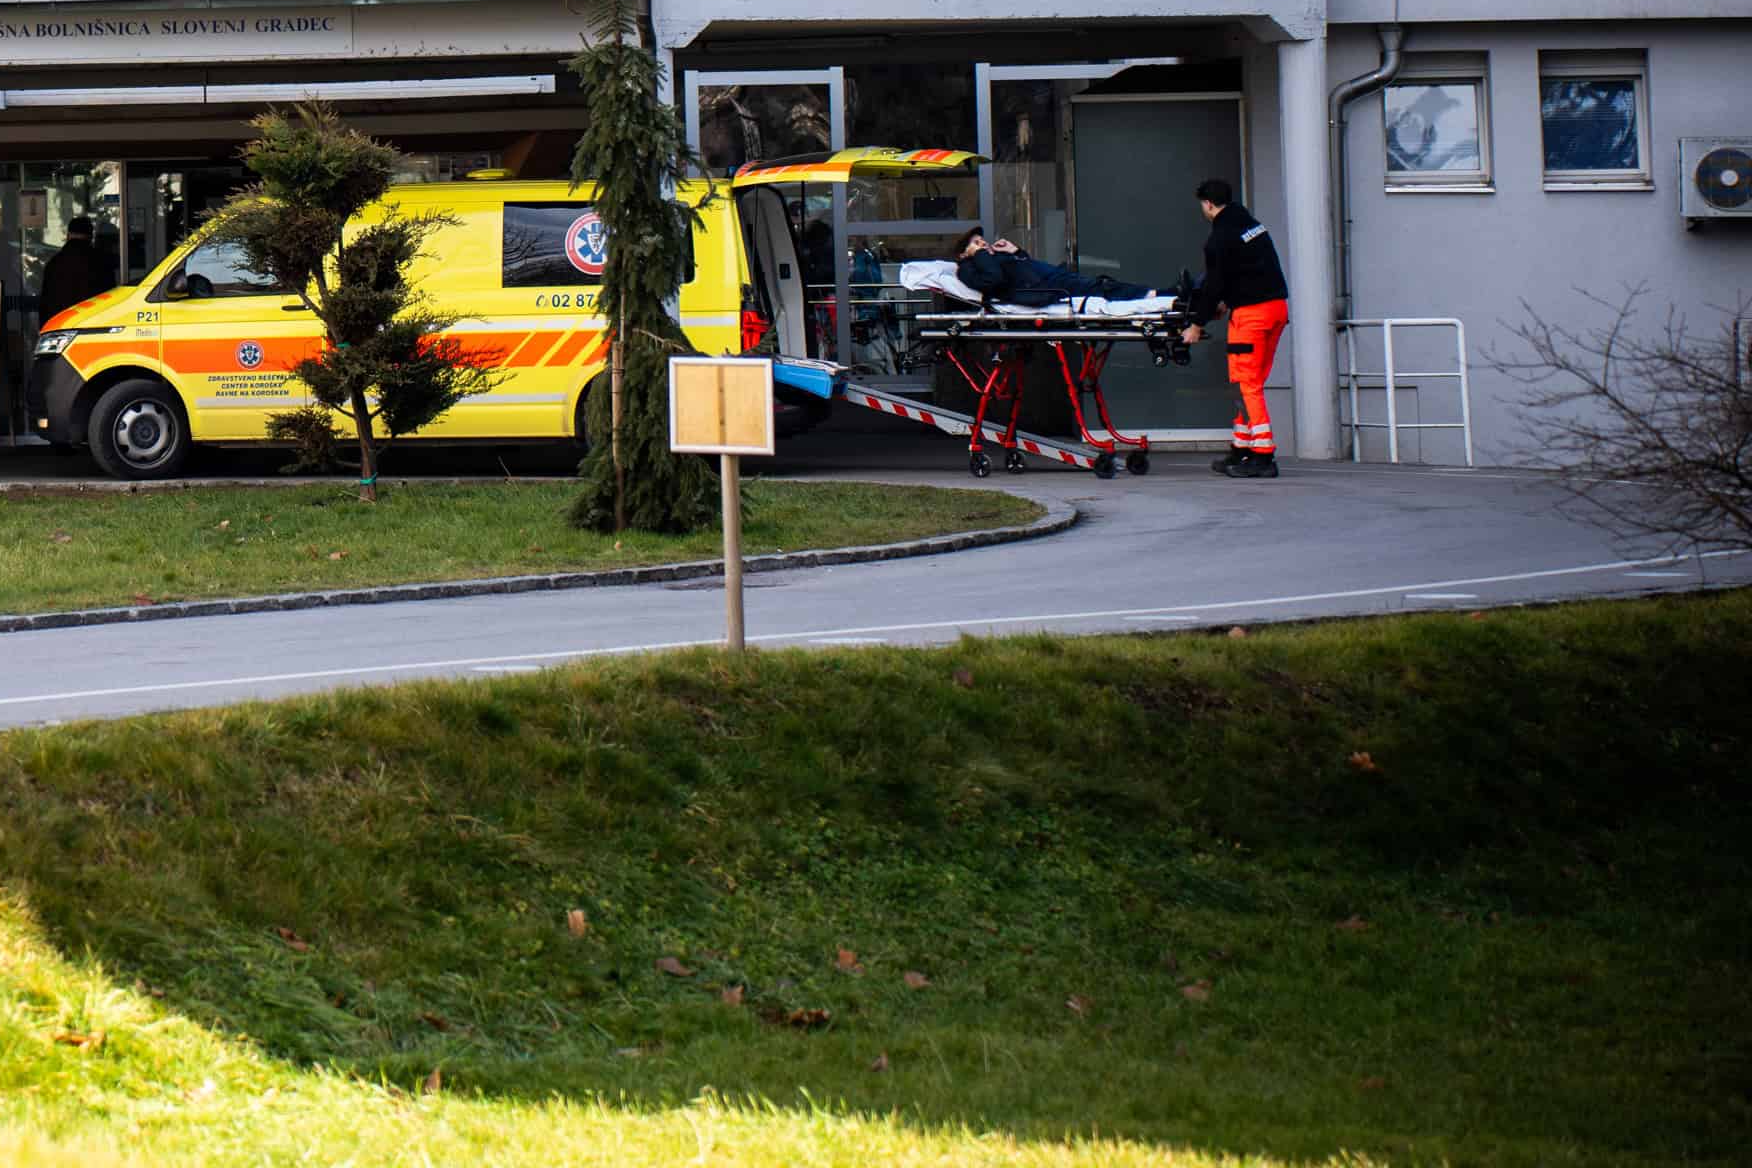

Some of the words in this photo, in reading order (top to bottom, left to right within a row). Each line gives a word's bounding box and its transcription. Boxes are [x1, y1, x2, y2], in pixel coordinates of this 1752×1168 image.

[35, 16, 151, 38] BOLNIŠNICA
[161, 18, 247, 35] SLOVENJ
[255, 16, 335, 33] GRADEC
[551, 294, 571, 308] 02
[137, 311, 159, 322] P21
